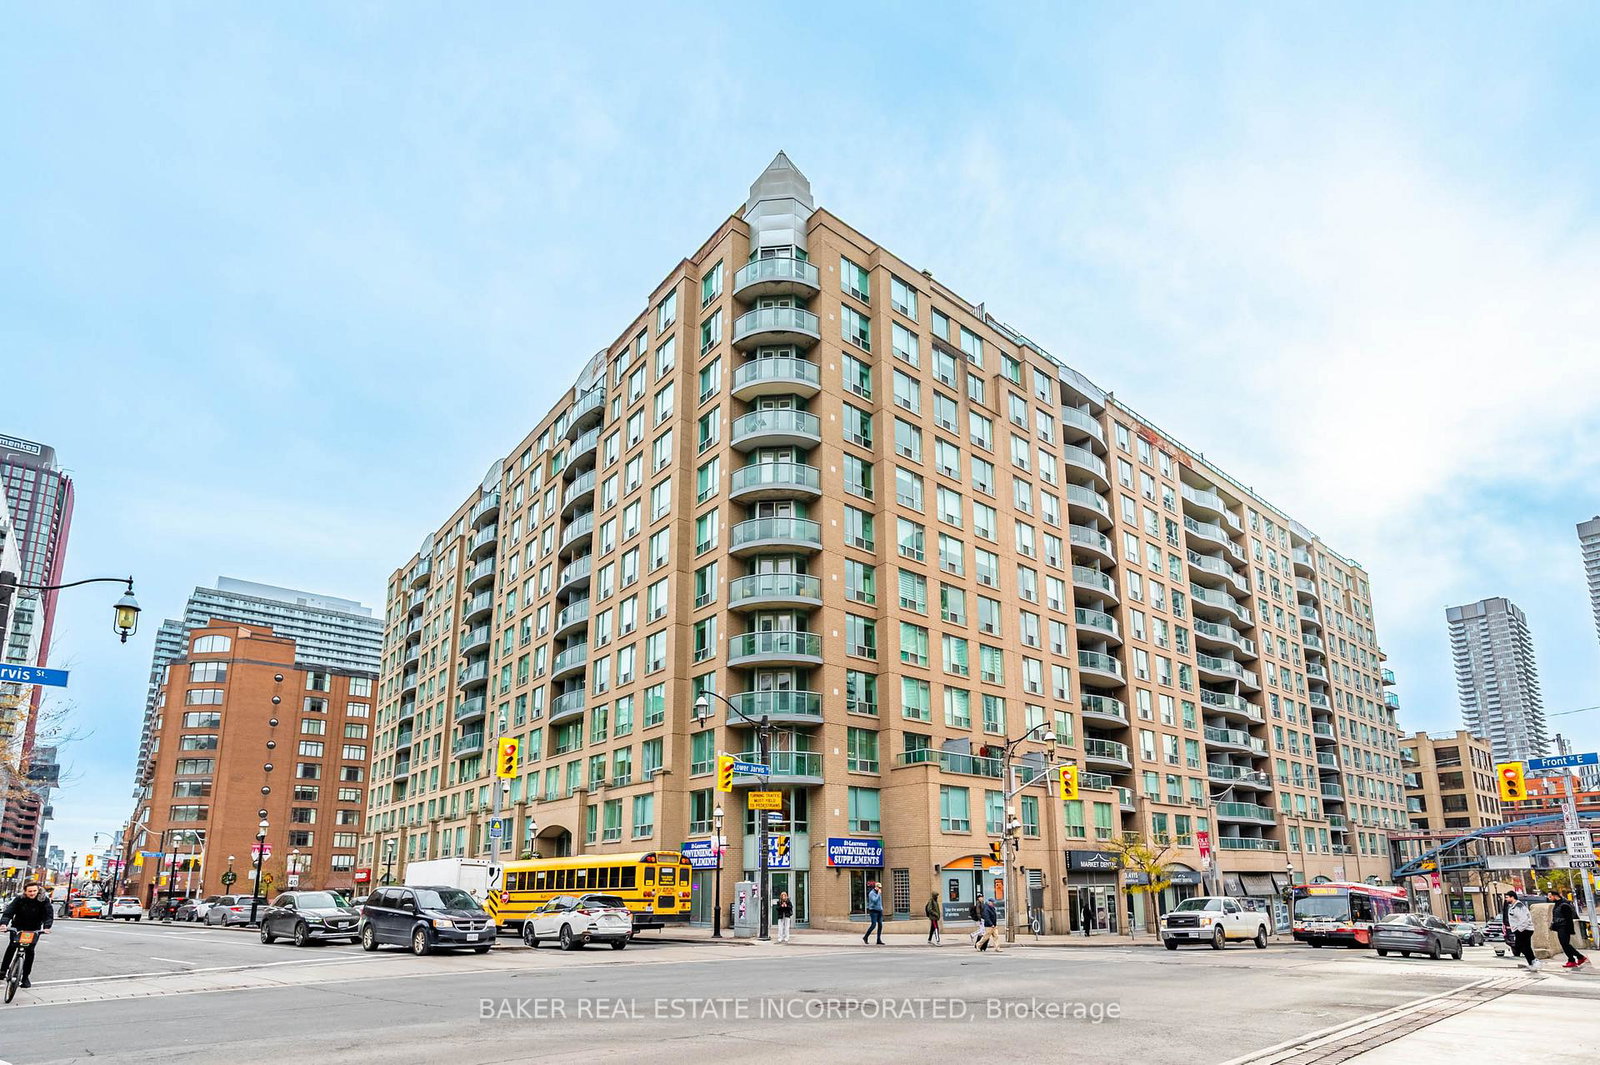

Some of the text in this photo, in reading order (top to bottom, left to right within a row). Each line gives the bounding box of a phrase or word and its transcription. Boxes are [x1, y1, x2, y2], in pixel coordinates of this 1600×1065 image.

[0, 667, 30, 680] rvis
[1541, 757, 1567, 767] Front
[1577, 754, 1583, 763] E
[734, 763, 749, 771] Lower
[750, 765, 765, 773] Jarvis
[830, 845, 882, 856] CONVENIENCE &
[690, 857, 718, 867] PPLEMENTS
[767, 851, 790, 866] APE
[833, 855, 880, 865] SUPPLEMENTS
